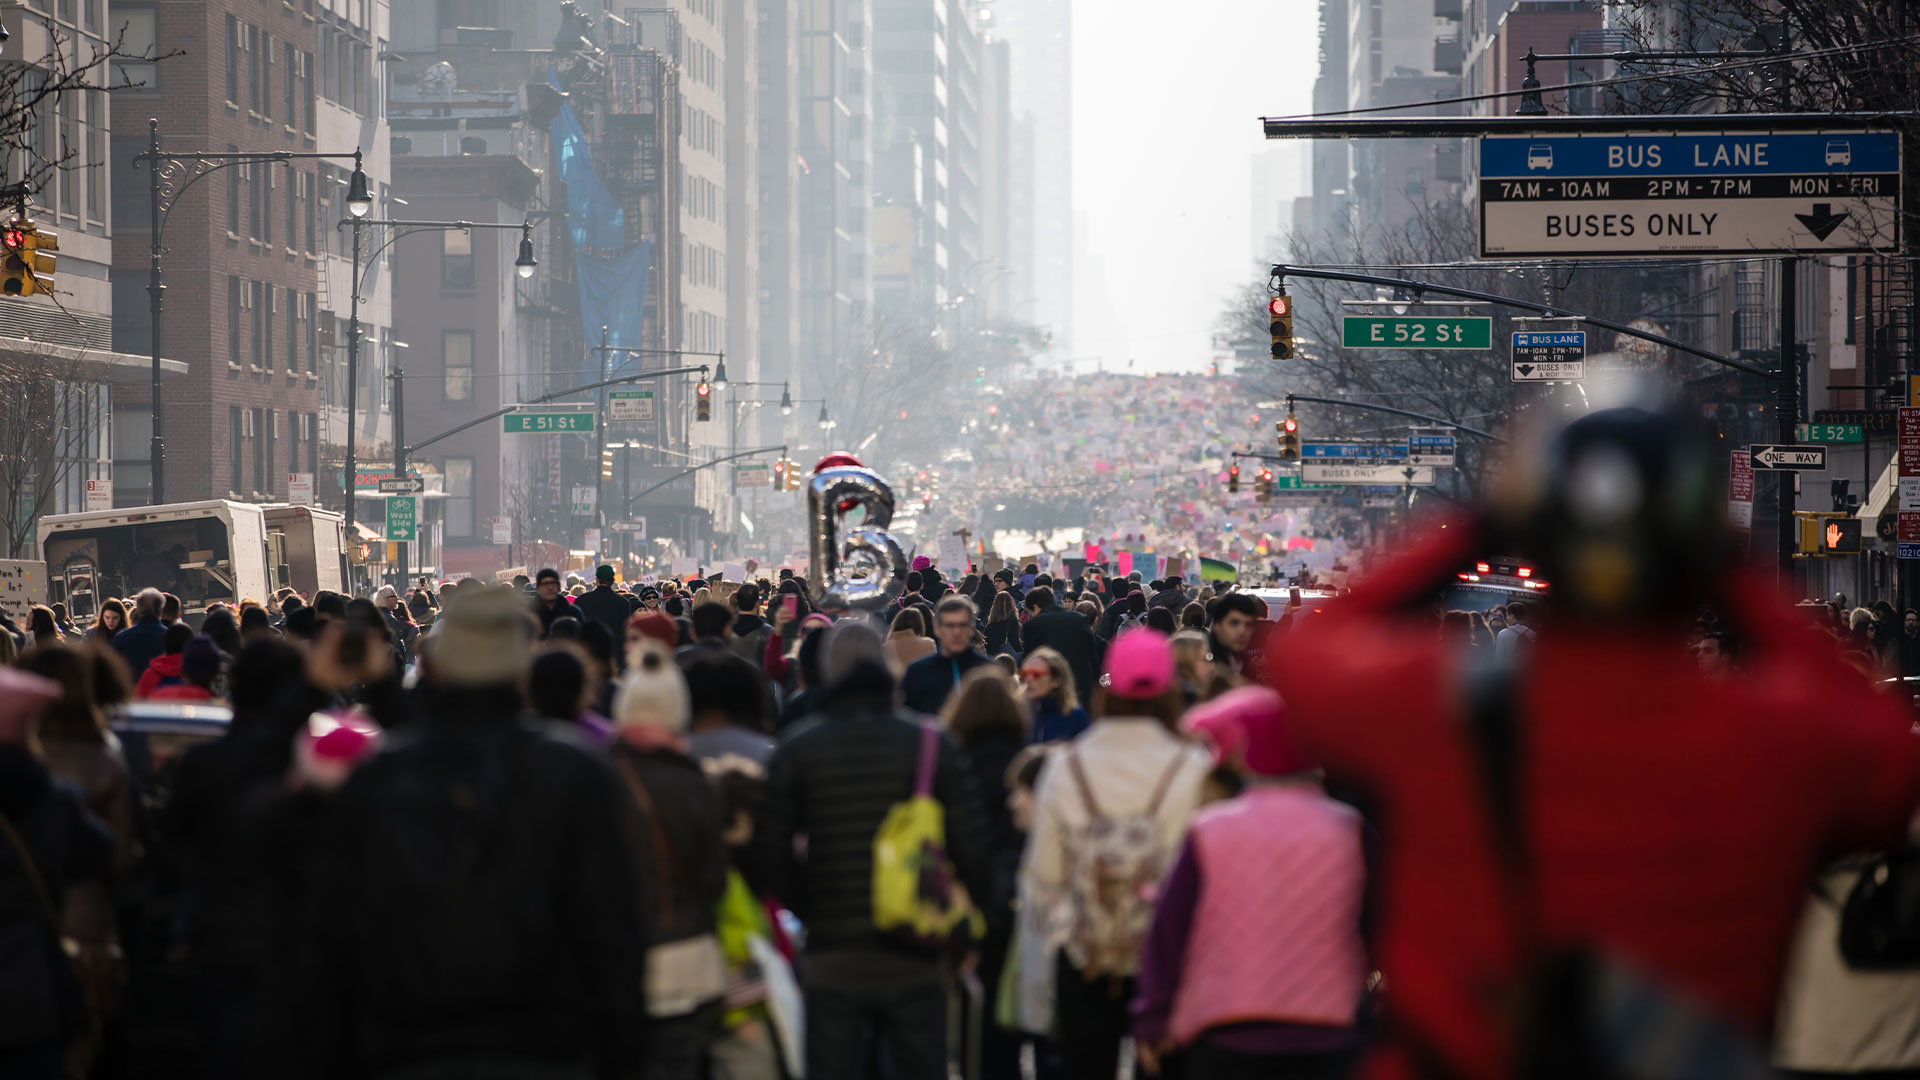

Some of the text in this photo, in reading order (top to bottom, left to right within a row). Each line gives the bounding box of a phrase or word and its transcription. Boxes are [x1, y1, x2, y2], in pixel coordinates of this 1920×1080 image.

[1608, 143, 1769, 168] BUS LANE
[1500, 182, 1541, 199] 7AM
[1561, 181, 1610, 198] 10AM
[1648, 180, 1689, 196] 2PM
[1710, 179, 1751, 196] 7PM
[1790, 178, 1830, 194] MON
[1850, 177, 1879, 193] FRI
[1546, 212, 1718, 238] BUSES ONLY
[1370, 324, 1463, 342] E 52 St
[1554, 336, 1580, 344] LANE
[522, 417, 575, 429] E 51 St
[1812, 426, 1820, 439] E
[1827, 426, 1844, 440] 52
[1765, 453, 1818, 463] ONE WAY
[1322, 468, 1376, 477] BUSES ONLY
[88, 481, 94, 490] 3
[8, 582, 23, 592] let
